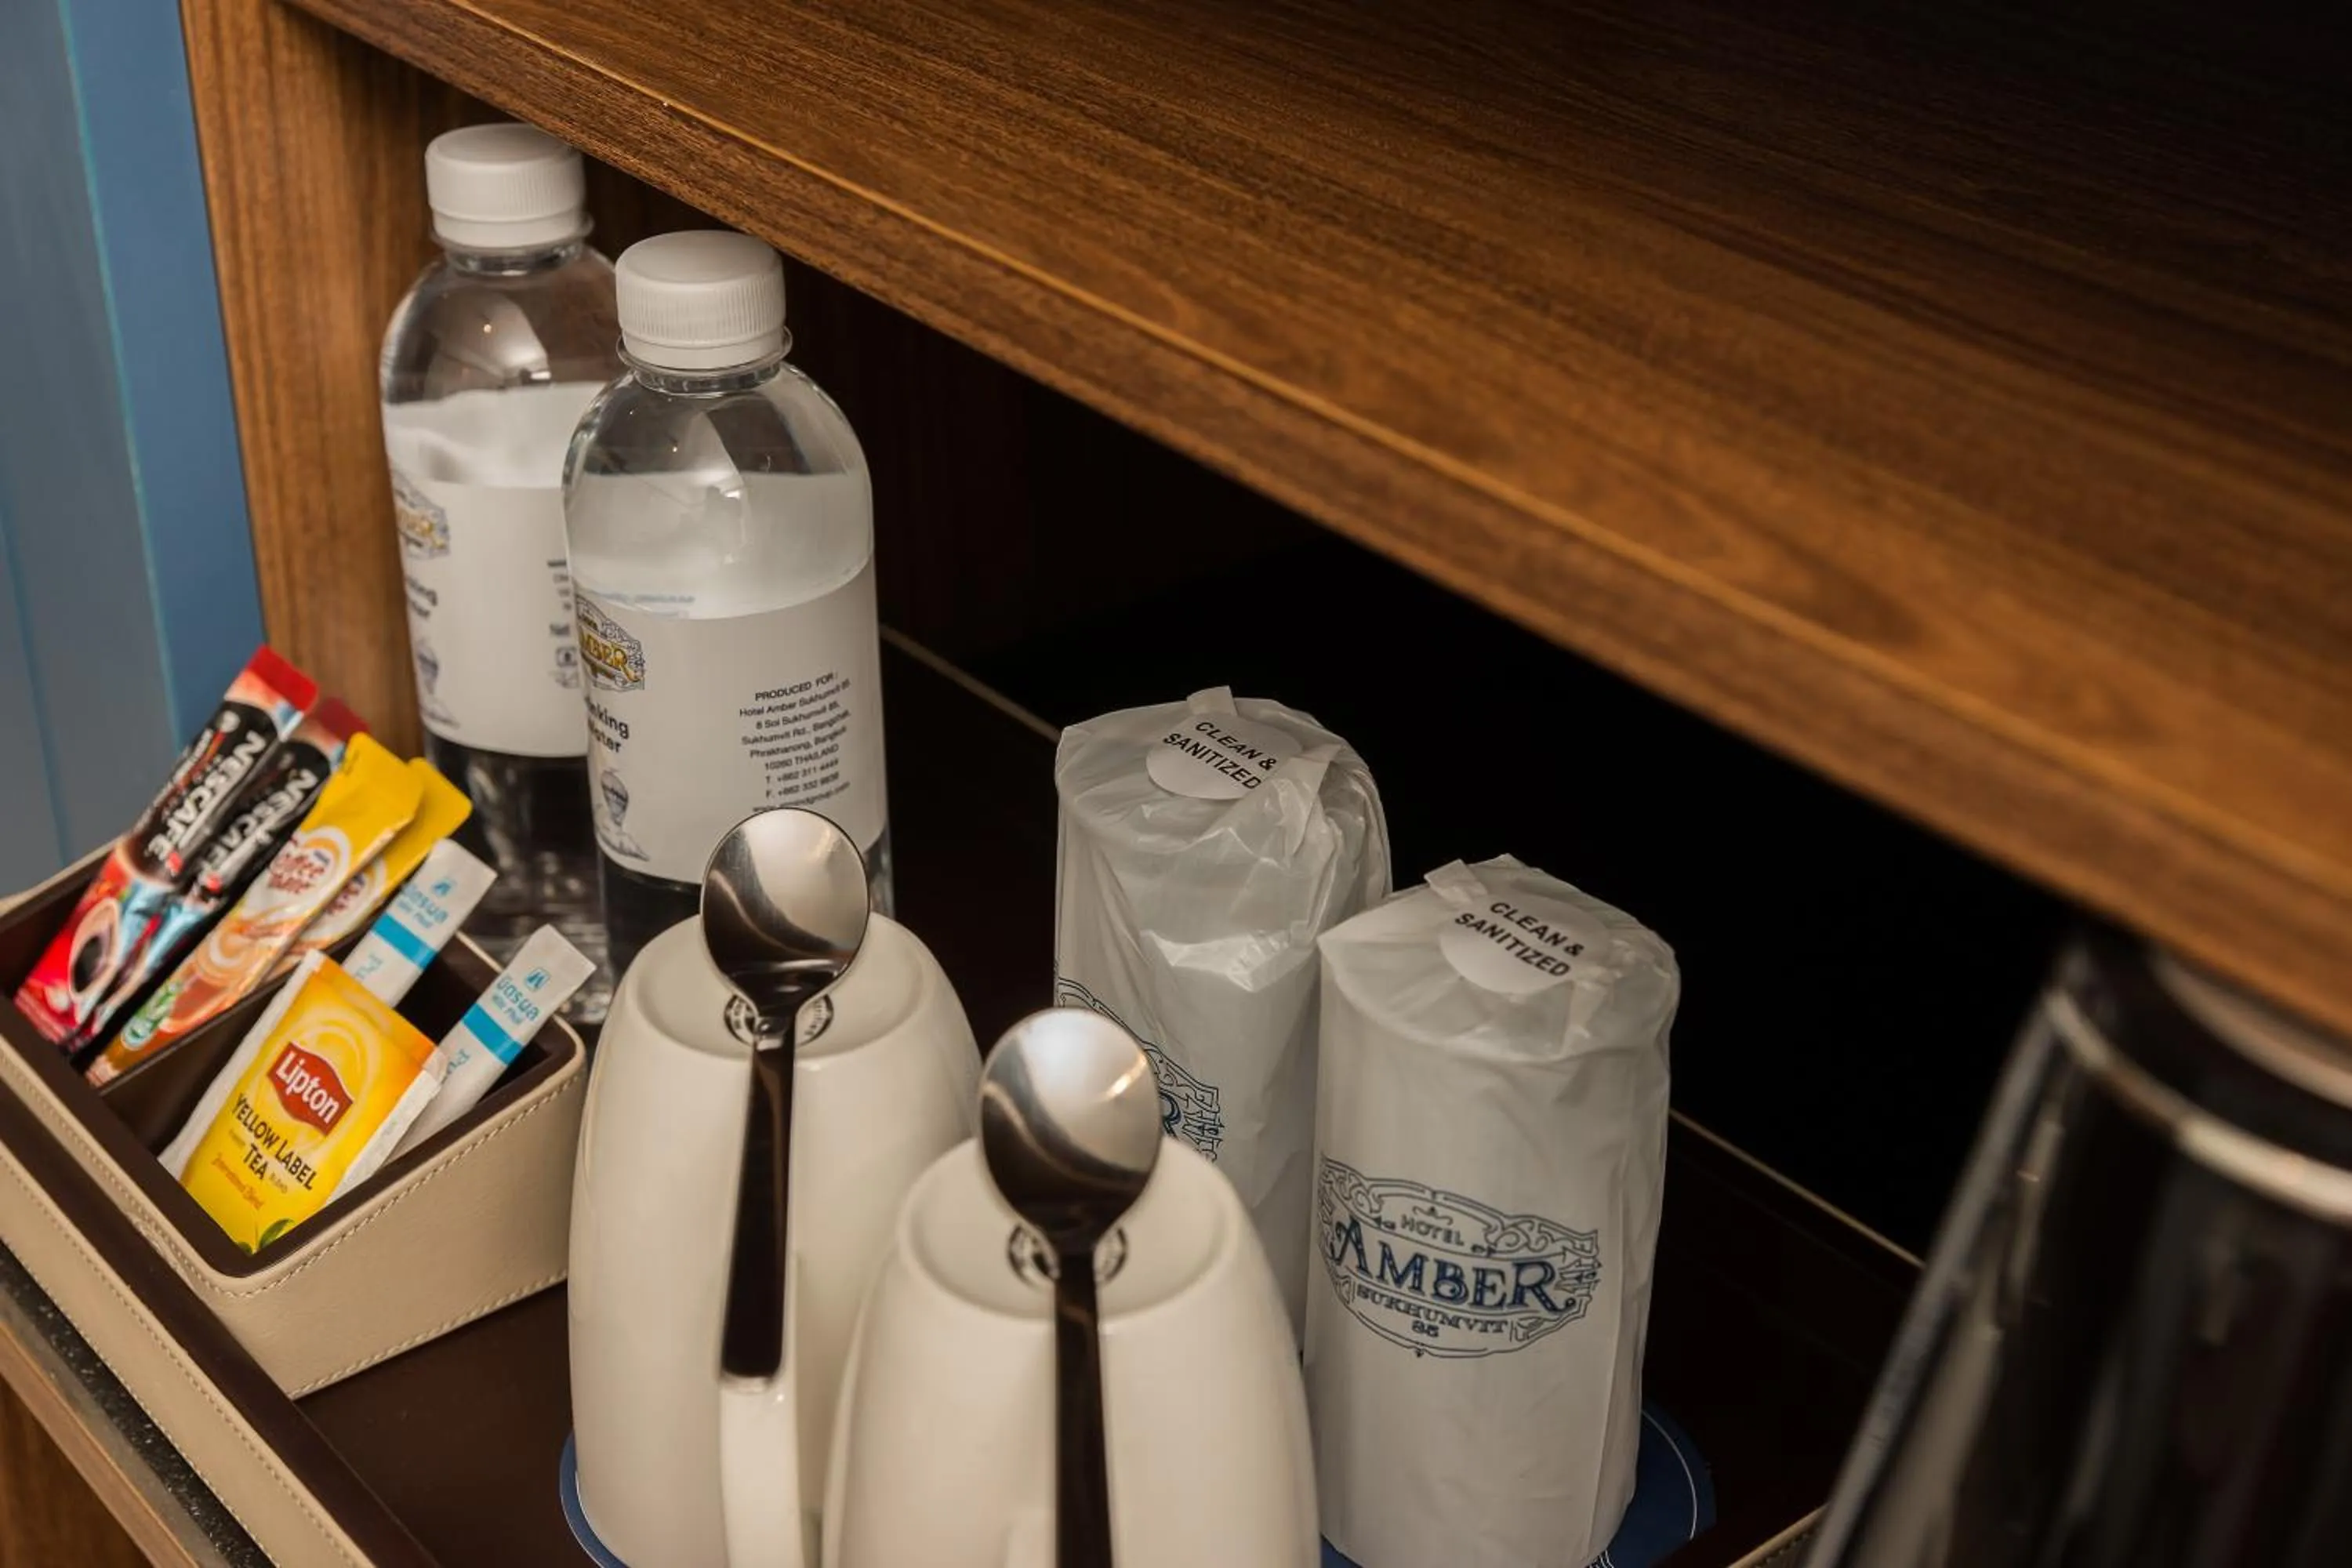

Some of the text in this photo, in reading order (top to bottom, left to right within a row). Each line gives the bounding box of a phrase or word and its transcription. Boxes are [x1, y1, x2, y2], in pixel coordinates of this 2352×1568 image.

[739, 706, 764, 717] Hotel
[766, 702, 797, 713] Amber
[755, 681, 811, 701] PRODUCED
[1163, 733, 1261, 789] SANITIZED
[1196, 721, 1277, 771] CLEAN &
[1454, 913, 1571, 977] SANITIZED
[1490, 902, 1584, 957] CLEAN &
[275, 1051, 339, 1123] Lipton
[232, 1094, 280, 1150] YELLOW
[274, 1139, 318, 1191] LABEL
[243, 1144, 268, 1180] TEA
[1401, 1214, 1464, 1247] HOTEL
[1330, 1214, 1576, 1314] AMBER
[1356, 1284, 1508, 1334] SUKHUMVIT
